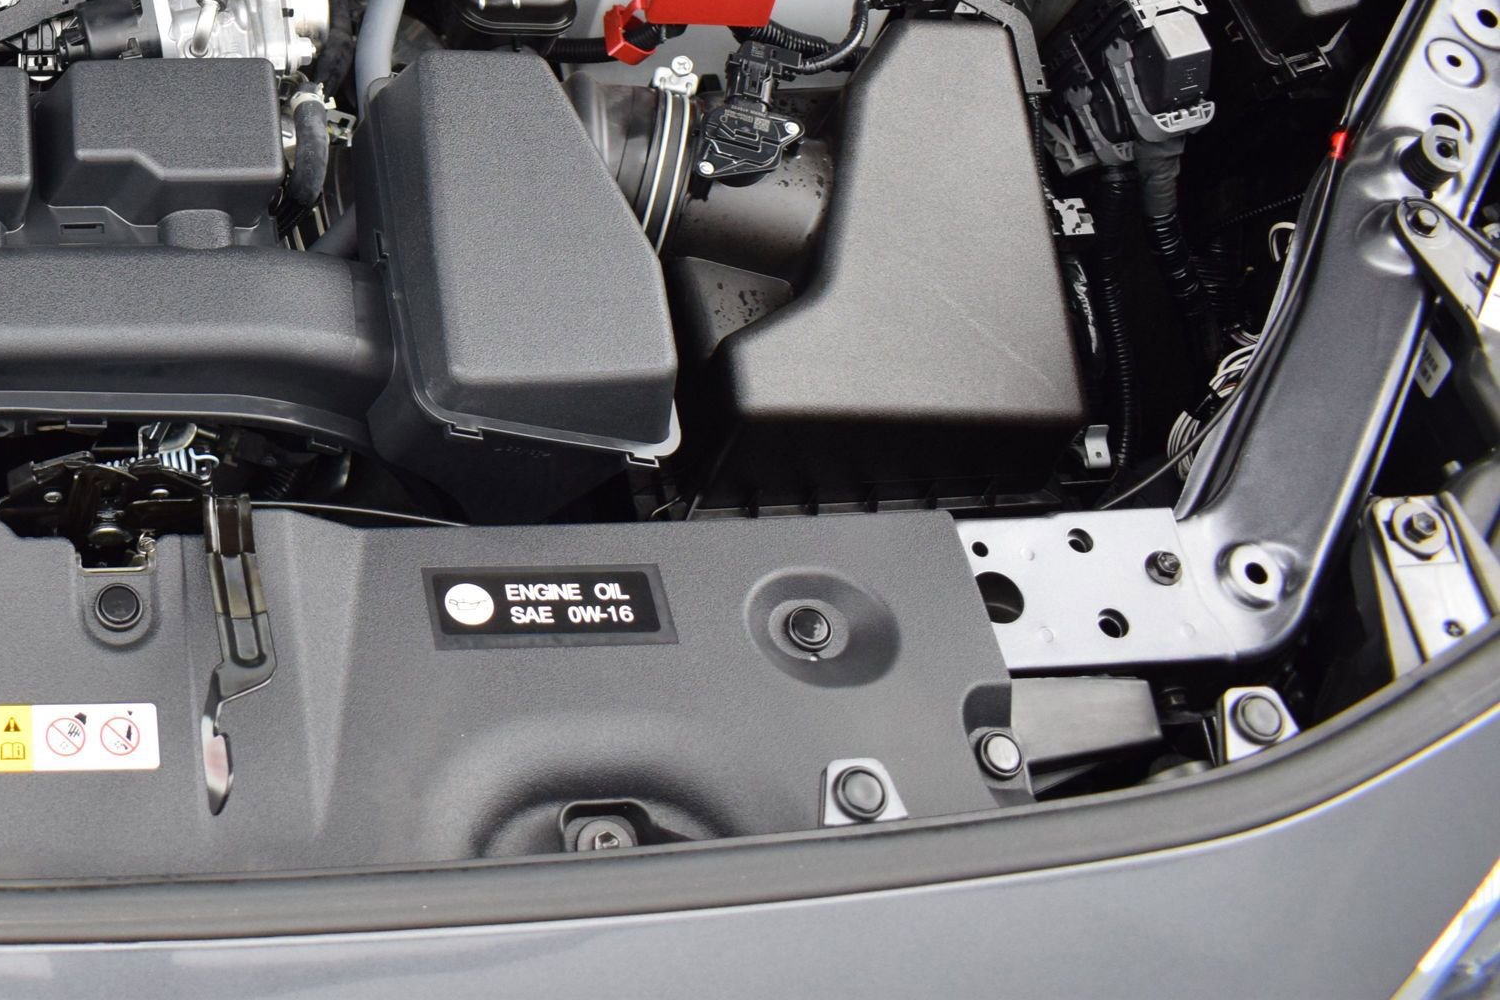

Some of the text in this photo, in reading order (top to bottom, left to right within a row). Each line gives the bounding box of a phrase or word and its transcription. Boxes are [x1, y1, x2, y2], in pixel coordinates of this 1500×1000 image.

[504, 582, 630, 601] ENGINE OIL
[510, 605, 635, 624] SAE 0W-16
